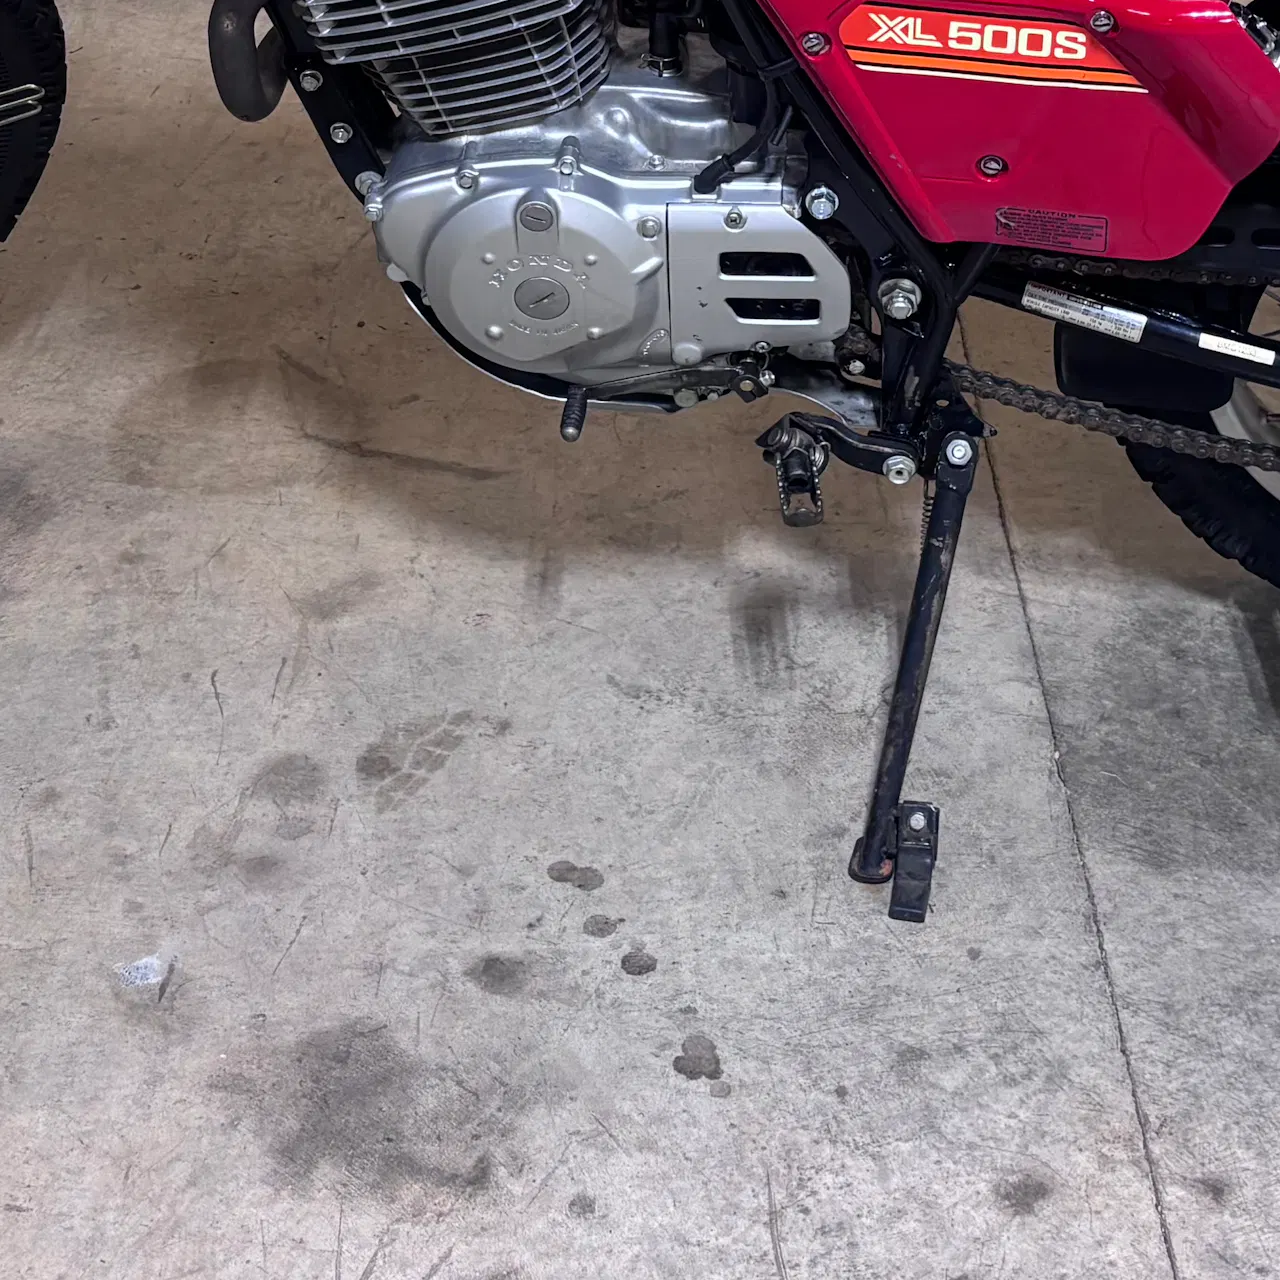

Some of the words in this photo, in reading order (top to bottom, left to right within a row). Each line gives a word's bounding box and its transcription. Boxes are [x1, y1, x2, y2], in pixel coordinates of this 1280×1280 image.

[867, 13, 943, 47] XL
[948, 21, 1086, 60] 500S
[488, 254, 590, 289] HONDA
